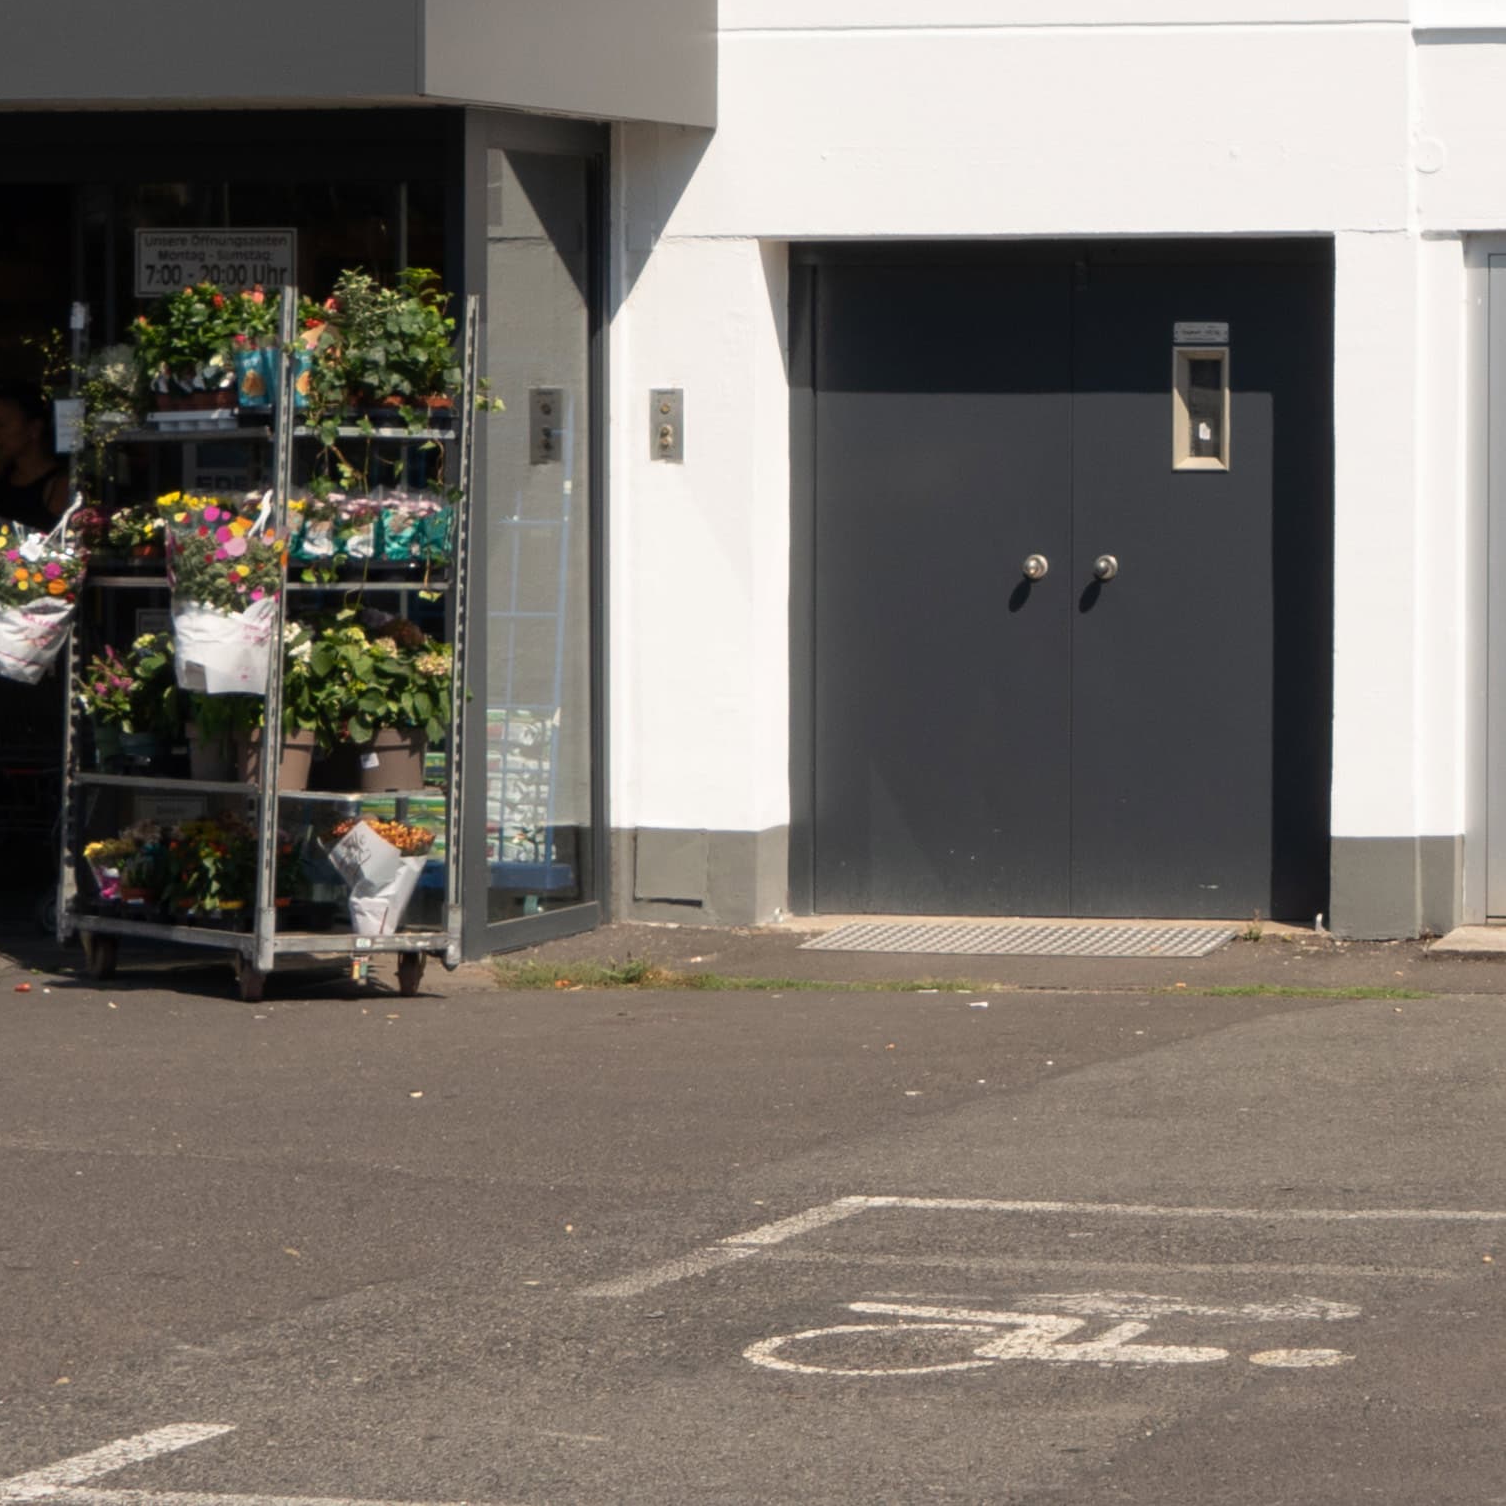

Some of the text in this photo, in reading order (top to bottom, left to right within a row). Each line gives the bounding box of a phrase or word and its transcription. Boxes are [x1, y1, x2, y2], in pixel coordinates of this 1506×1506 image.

[145, 234, 287, 248] Unsere Öffnungszeiten
[158, 250, 205, 262] Montag
[145, 265, 181, 285] 7:00
[200, 264, 247, 285] 20:00
[253, 262, 287, 285] Uhr
